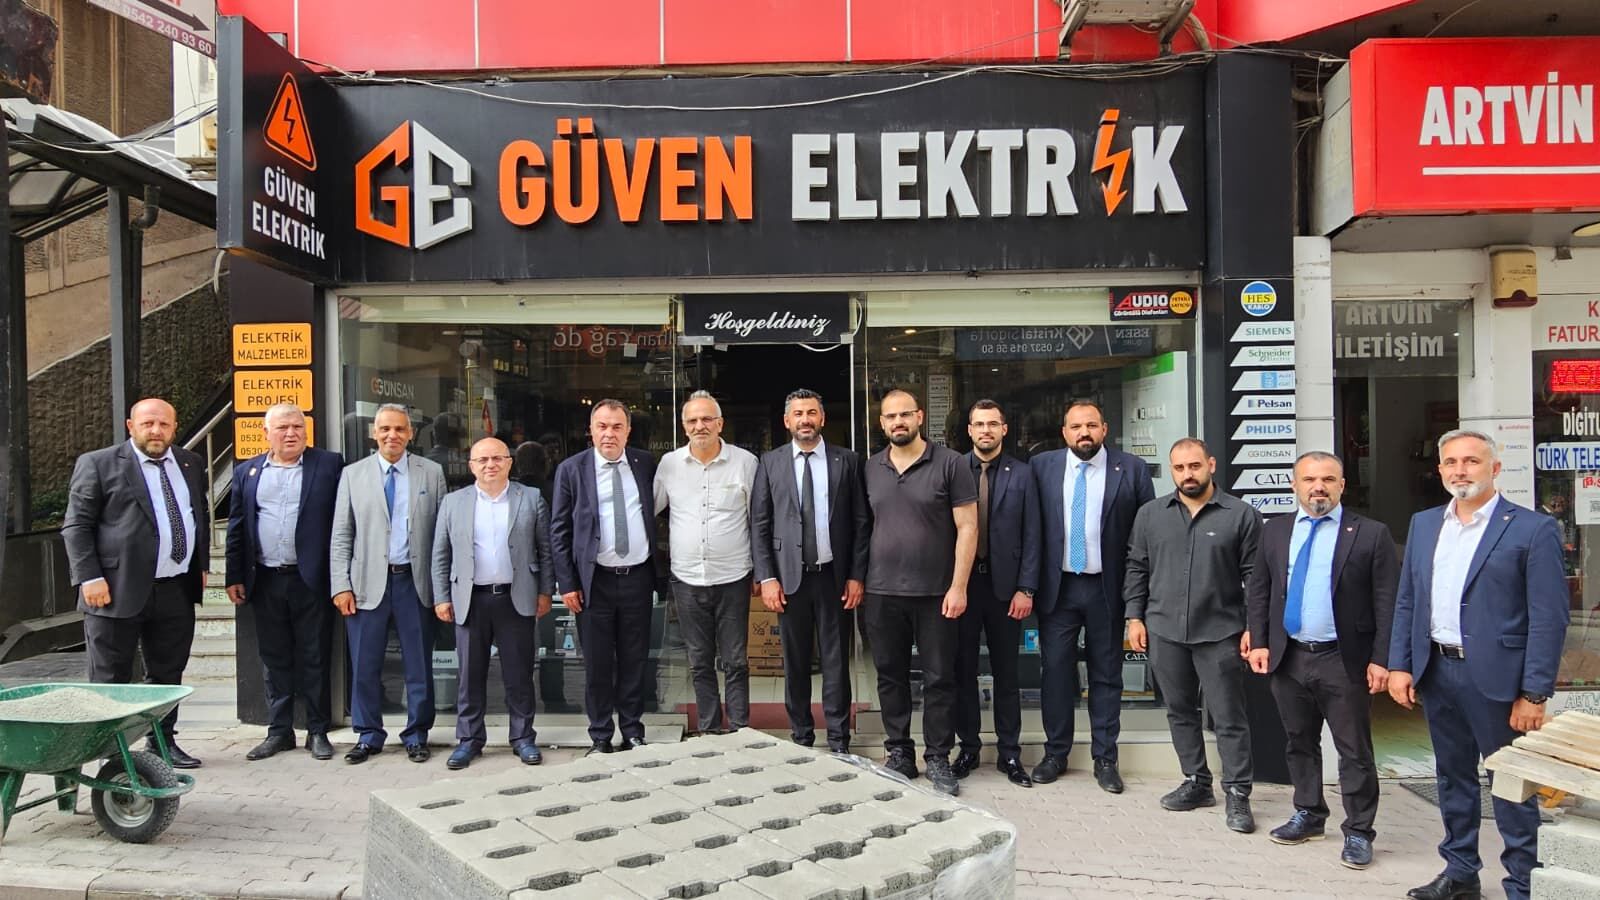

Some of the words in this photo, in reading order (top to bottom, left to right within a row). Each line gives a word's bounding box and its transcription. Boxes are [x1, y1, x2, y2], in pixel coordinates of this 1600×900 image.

[123, 5, 154, 28] 0542
[158, 20, 178, 38] 240
[181, 31, 196, 47] 93
[198, 41, 212, 55] 60
[1419, 71, 1594, 145] ARTVİN
[499, 117, 754, 227] GÜVEN
[791, 108, 1189, 222] ELEKTRİK
[264, 165, 315, 218] GÜVEN
[252, 200, 326, 260] ELEKTRİK
[1116, 294, 1168, 309] AUDIO
[1247, 294, 1271, 303] HES
[704, 311, 831, 337] Hoşgeldiniz
[242, 330, 303, 344] ELEKTRİK
[1246, 327, 1291, 336] SIEMENS
[1548, 325, 1600, 343] FATUR
[238, 345, 307, 360] MALZEMELERİ
[1335, 332, 1444, 362] İLETİŞİM
[1248, 349, 1291, 360] Schneider
[242, 376, 303, 390] ELEKTRİK
[247, 392, 298, 406] PROJESİ
[1257, 399, 1292, 408] Pelsan
[241, 421, 263, 429] 0466
[1246, 425, 1292, 434] PHILIPS
[240, 434, 262, 442] 0532
[240, 447, 262, 455] 0530
[1538, 441, 1569, 469] TÜRK
[1254, 473, 1292, 486] CATA
[1251, 497, 1293, 510] ENTES
